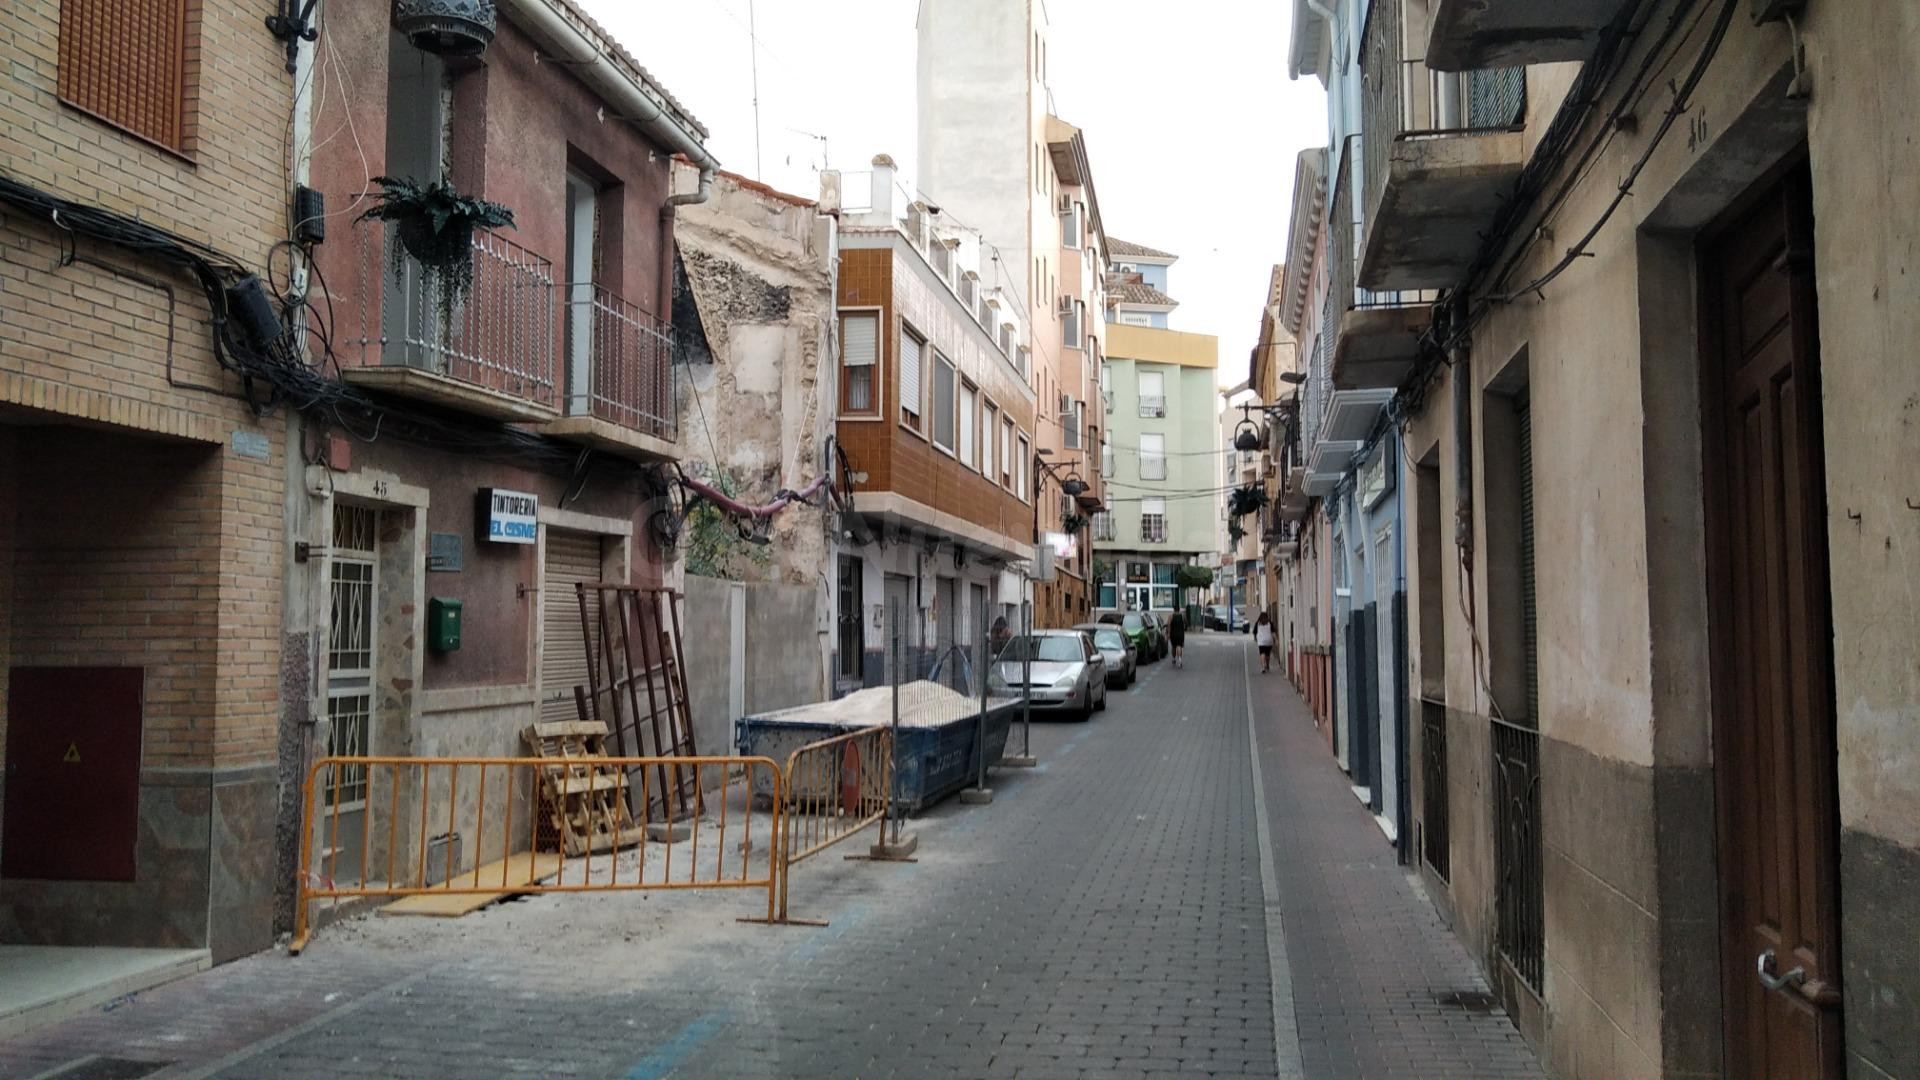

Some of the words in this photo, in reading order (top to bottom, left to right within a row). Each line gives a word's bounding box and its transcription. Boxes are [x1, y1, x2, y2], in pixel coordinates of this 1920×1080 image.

[1688, 105, 1707, 152] 46
[373, 480, 387, 497] 45
[493, 494, 536, 516] TINTORERIA
[491, 520, 503, 536] EL
